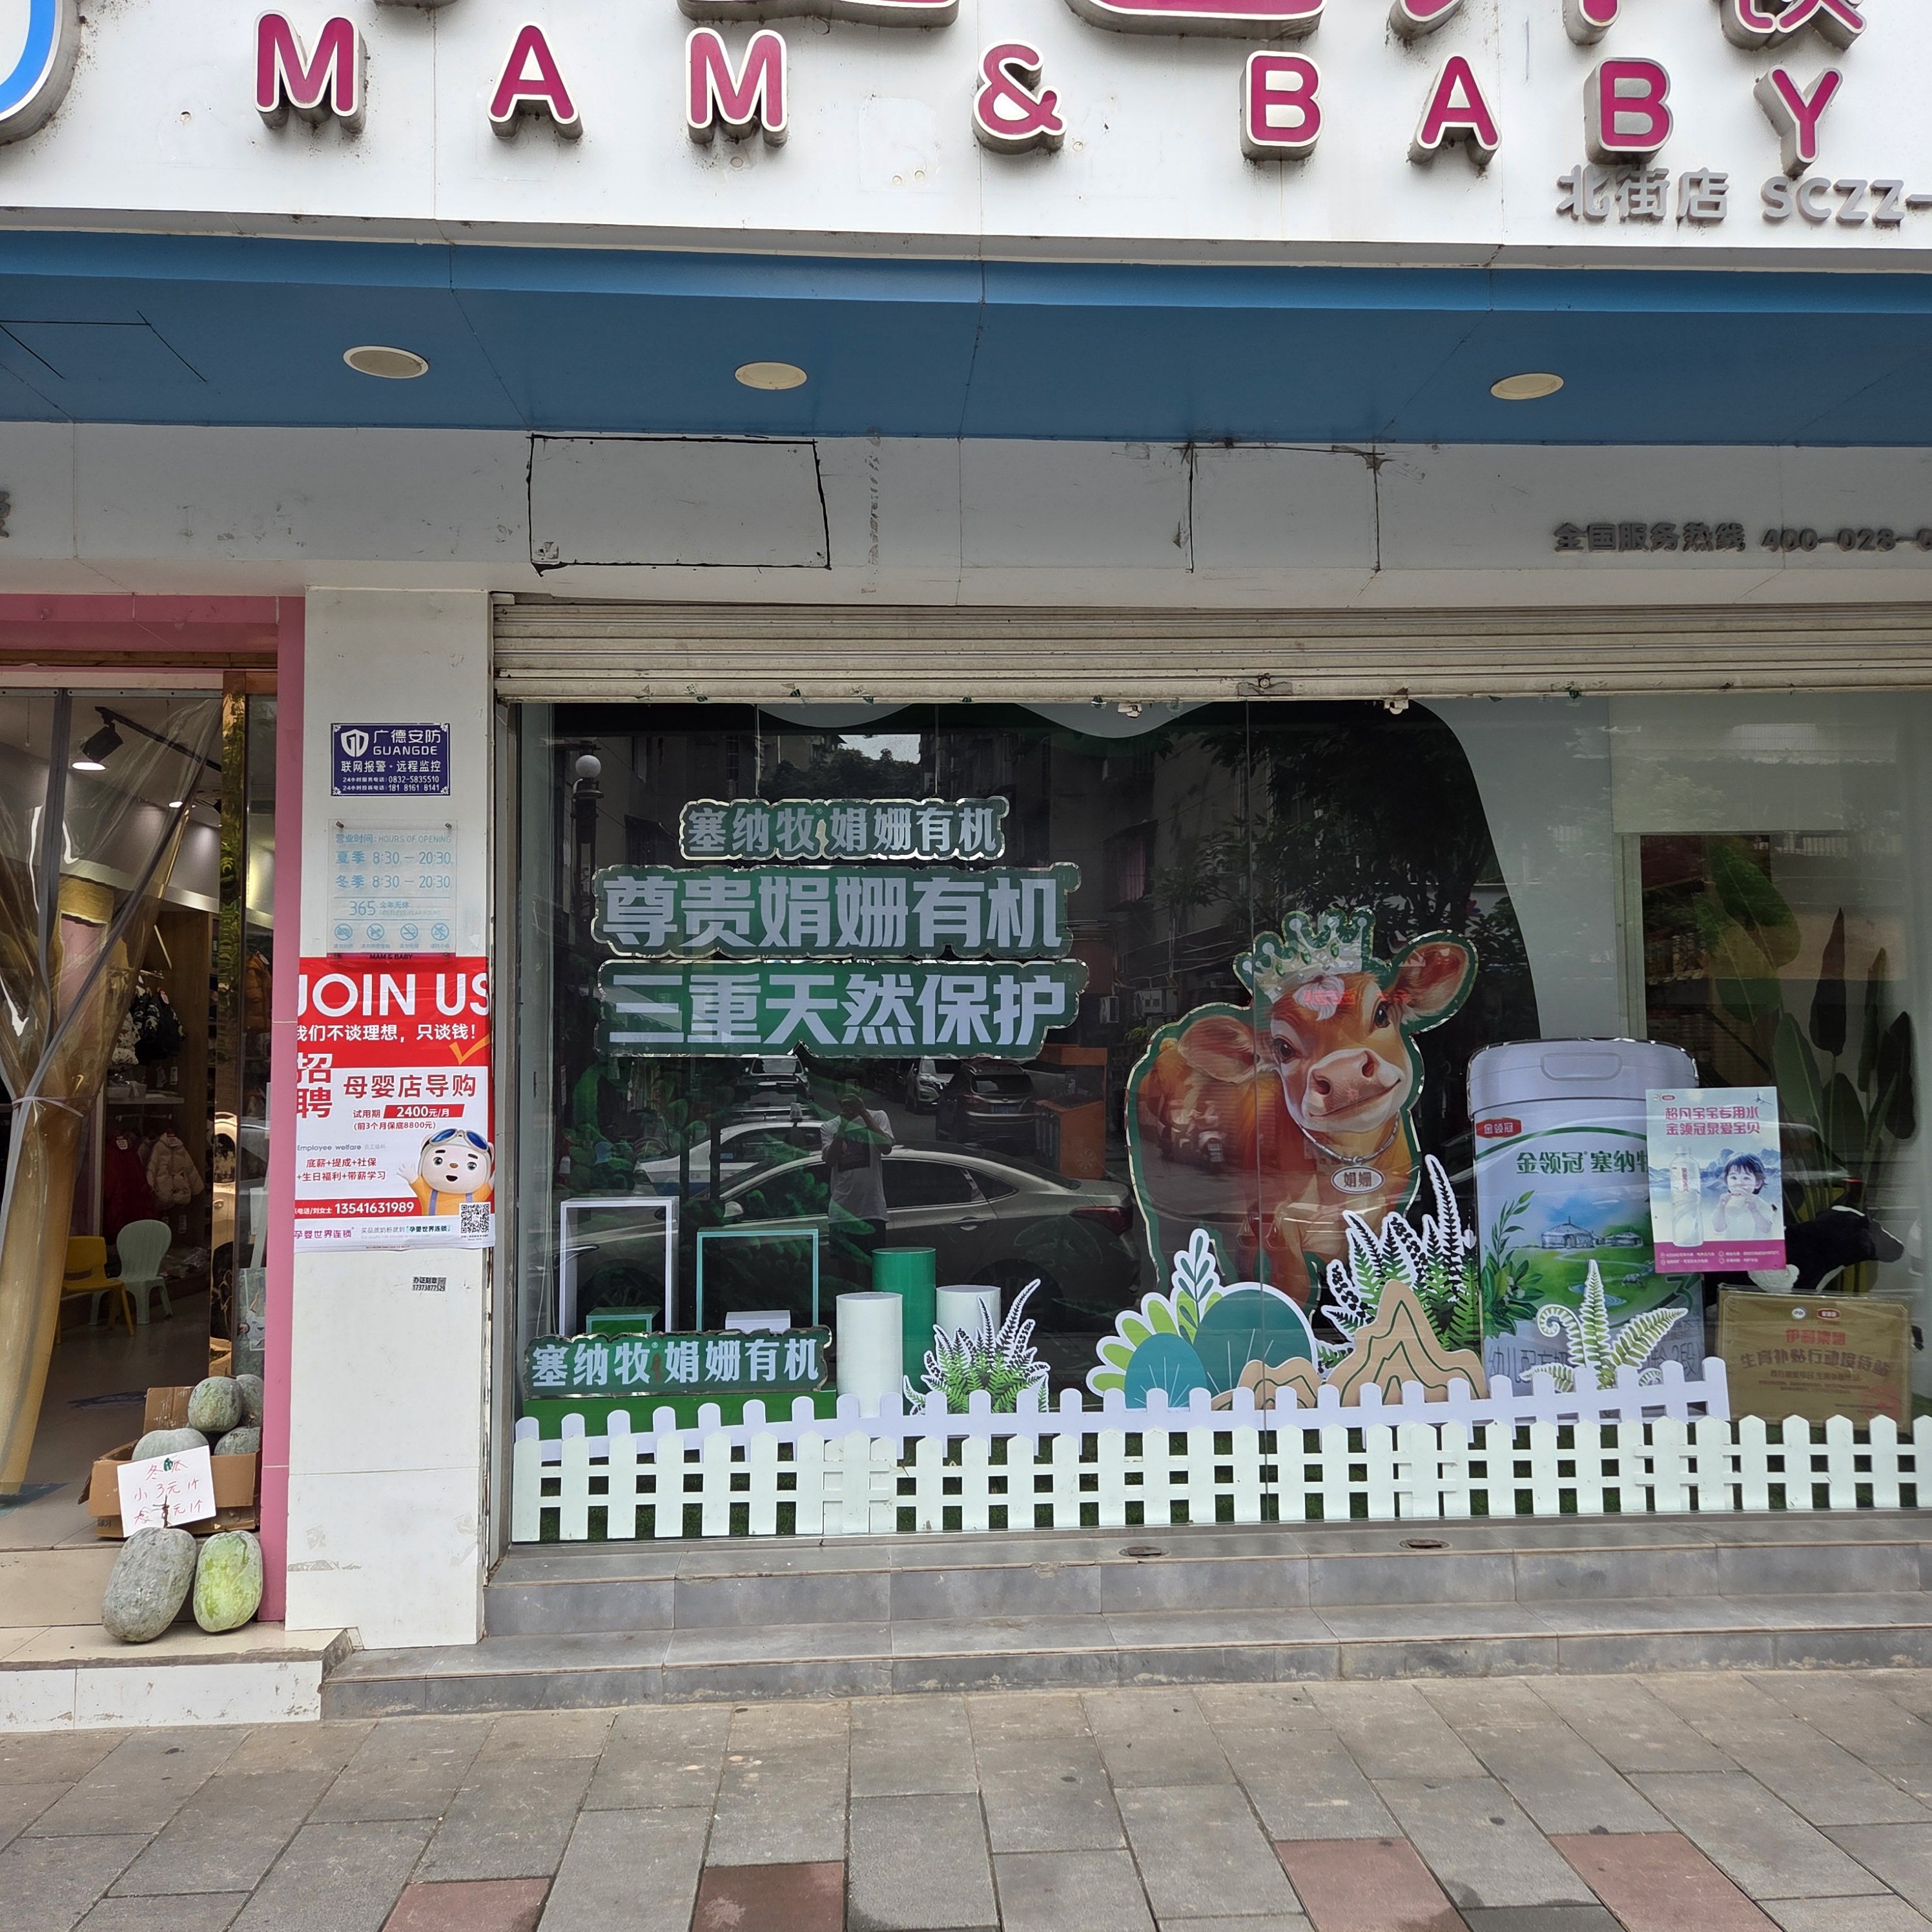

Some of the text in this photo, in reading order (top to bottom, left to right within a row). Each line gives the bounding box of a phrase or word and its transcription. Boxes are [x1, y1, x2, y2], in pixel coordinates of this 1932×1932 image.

[252, 9, 1844, 170] MAM & BABY
[1557, 164, 1729, 220] 北街店
[1554, 522, 1746, 552] 全国服务热线
[373, 730, 441, 743] 广德安防
[373, 746, 438, 755] GUANGDE
[335, 850, 365, 864] 夏季
[373, 851, 400, 865] 8:30
[419, 851, 451, 865] 20:30
[335, 875, 365, 888] 冬季
[372, 875, 400, 889] 8:30
[419, 875, 451, 889] 20:30
[349, 900, 376, 916] 365
[603, 876, 1062, 948] 尊贵娟姗有机
[297, 973, 489, 1017] JOIN US
[610, 973, 1065, 1045] 三重天然保护
[296, 1053, 333, 1118] 招聘
[344, 1074, 477, 1098] 母婴店导购
[353, 1105, 449, 1118] 试用期 2400元/月
[1483, 1122, 1514, 1135] 金领冠
[306, 1157, 376, 1168] 底薪+提成+社保
[1343, 1171, 1372, 1188] 娟姗
[294, 1201, 415, 1215] 电话/刘女士 13541631989
